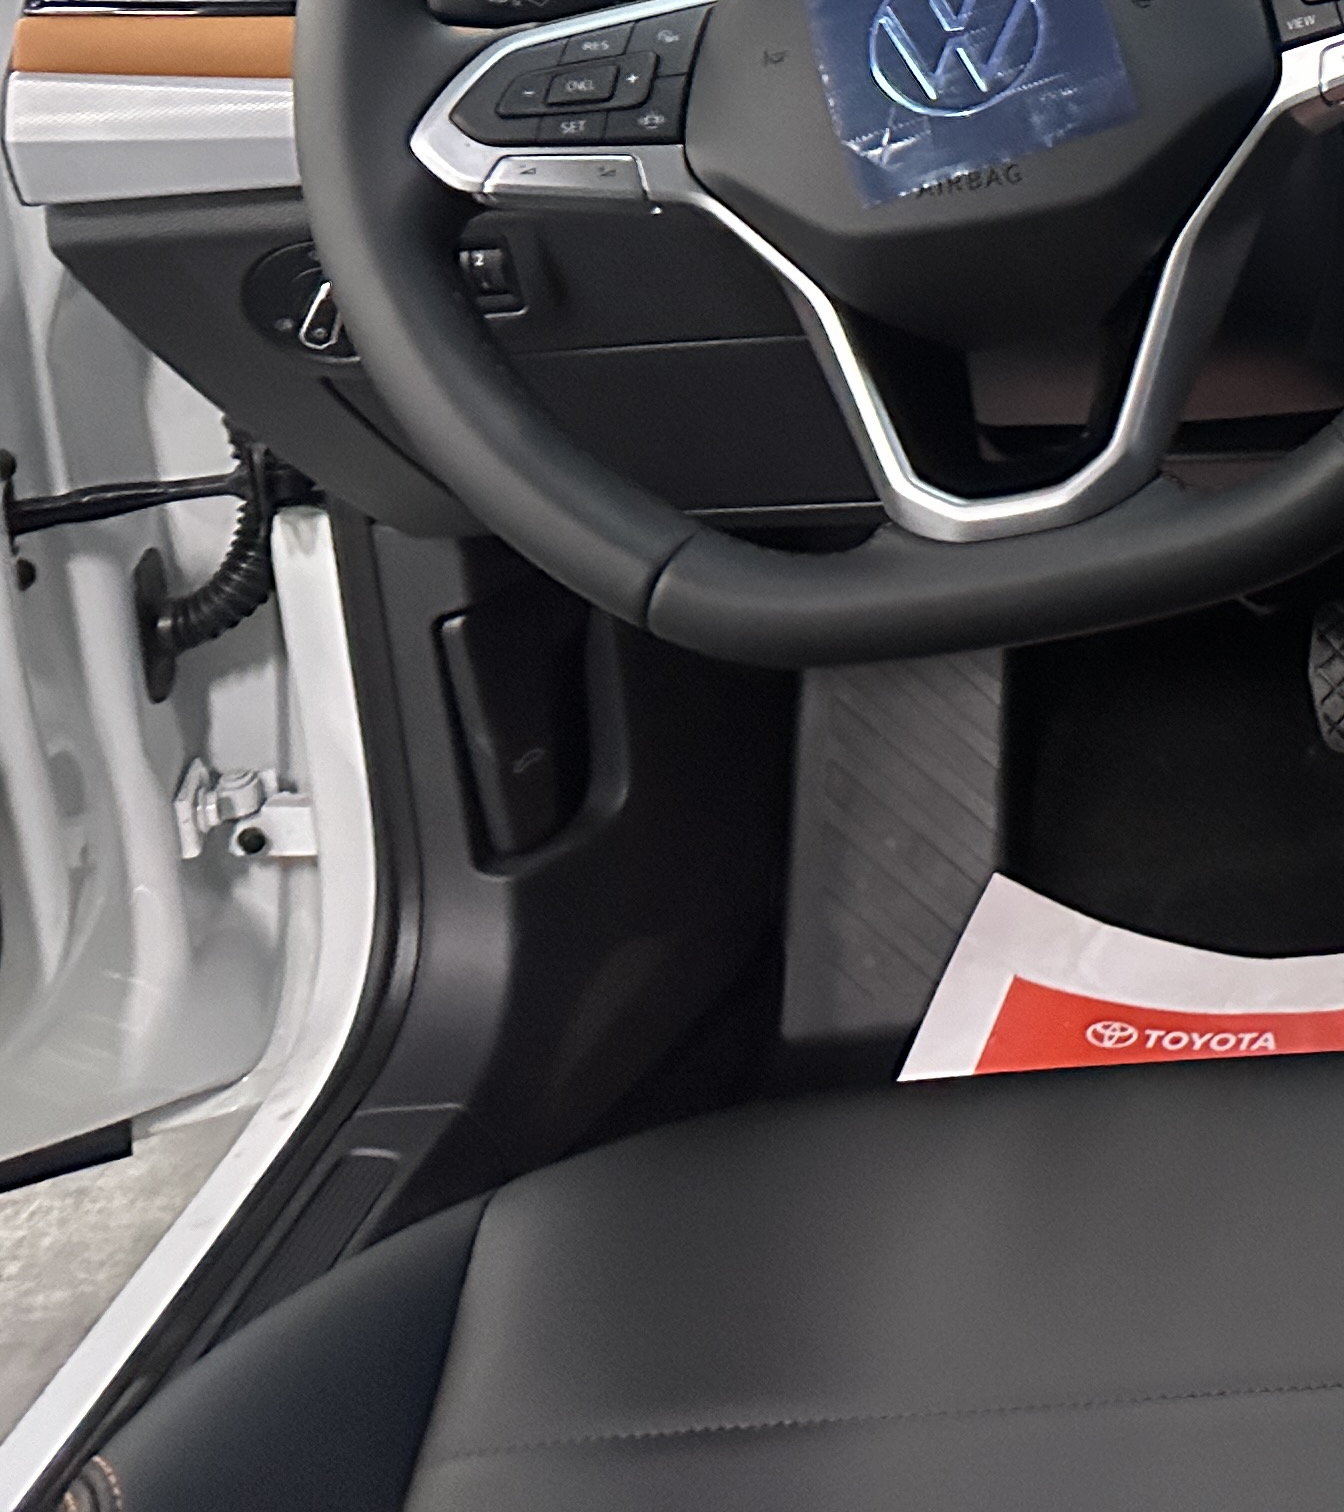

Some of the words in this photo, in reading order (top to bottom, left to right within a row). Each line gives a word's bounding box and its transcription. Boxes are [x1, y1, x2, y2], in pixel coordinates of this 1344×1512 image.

[1286, 14, 1316, 31] VIEW
[581, 39, 610, 51] RES
[560, 120, 587, 135] SET
[1143, 1028, 1277, 1052] TOYOTA
